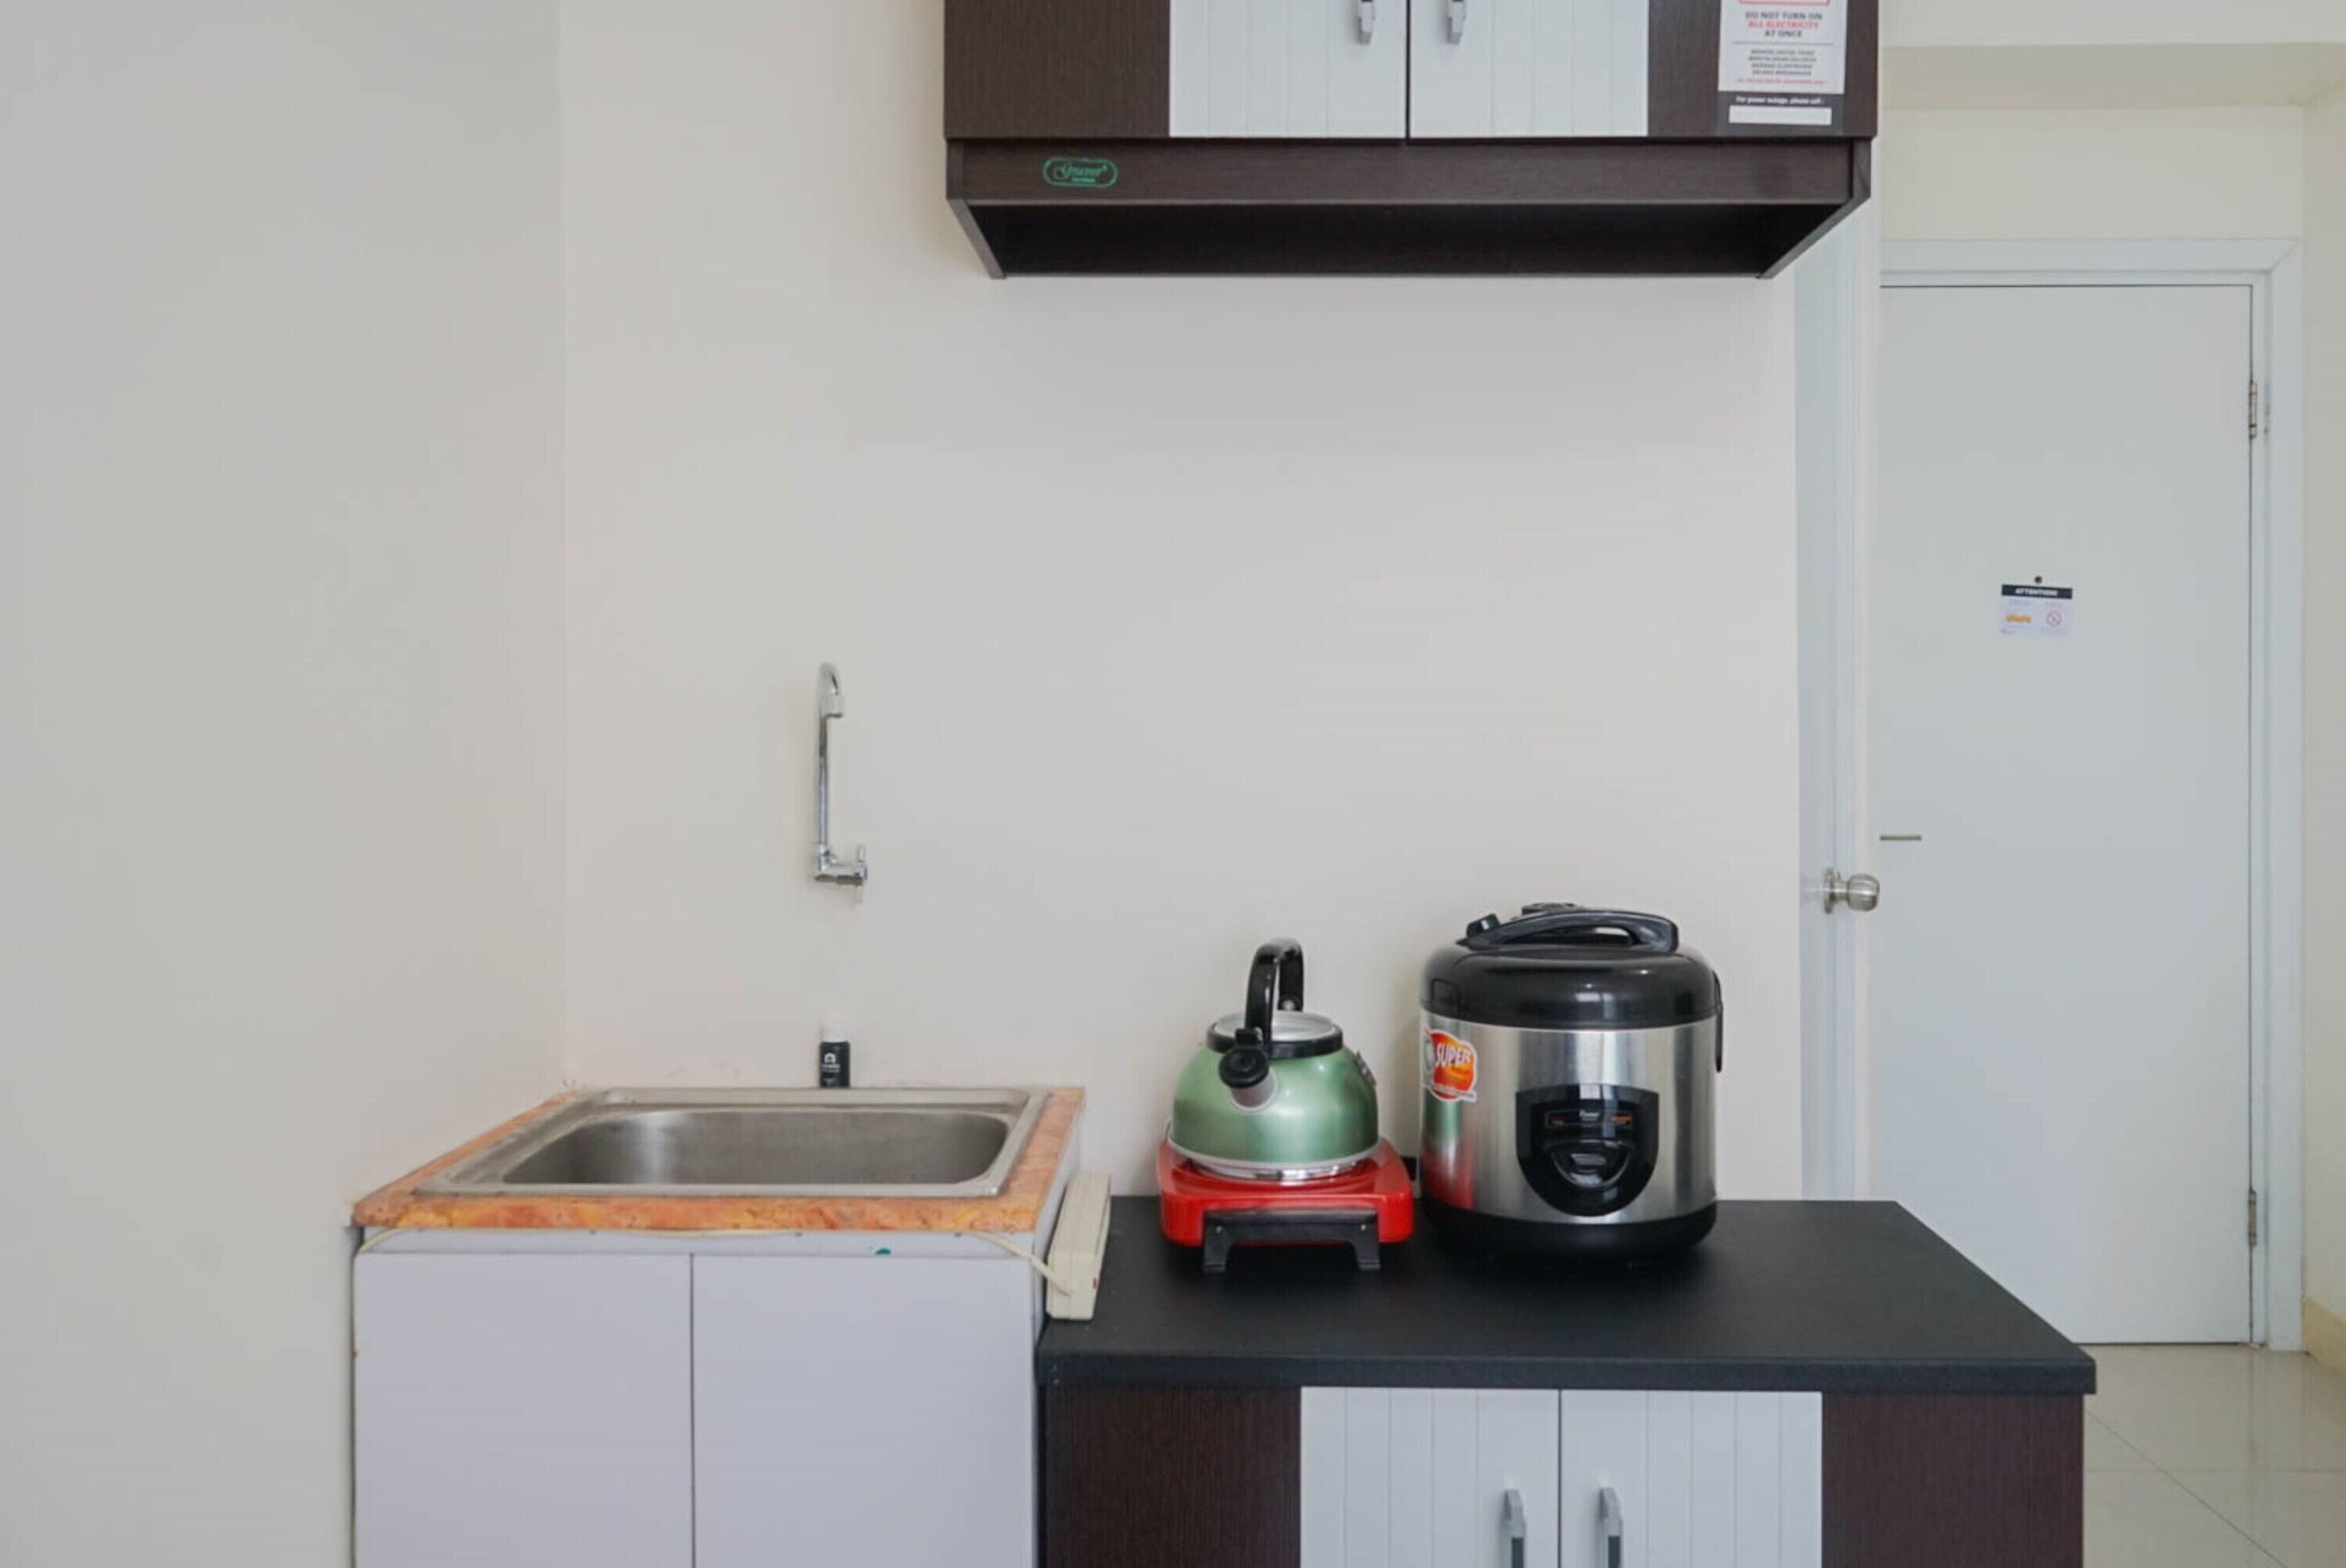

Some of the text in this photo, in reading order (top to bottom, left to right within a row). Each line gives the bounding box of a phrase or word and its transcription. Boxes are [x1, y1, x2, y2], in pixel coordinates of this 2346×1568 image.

[1782, 12, 1806, 20] TURN
[1767, 21, 1819, 30] ELECTRICITY
[1436, 1042, 1472, 1066] SUPER
